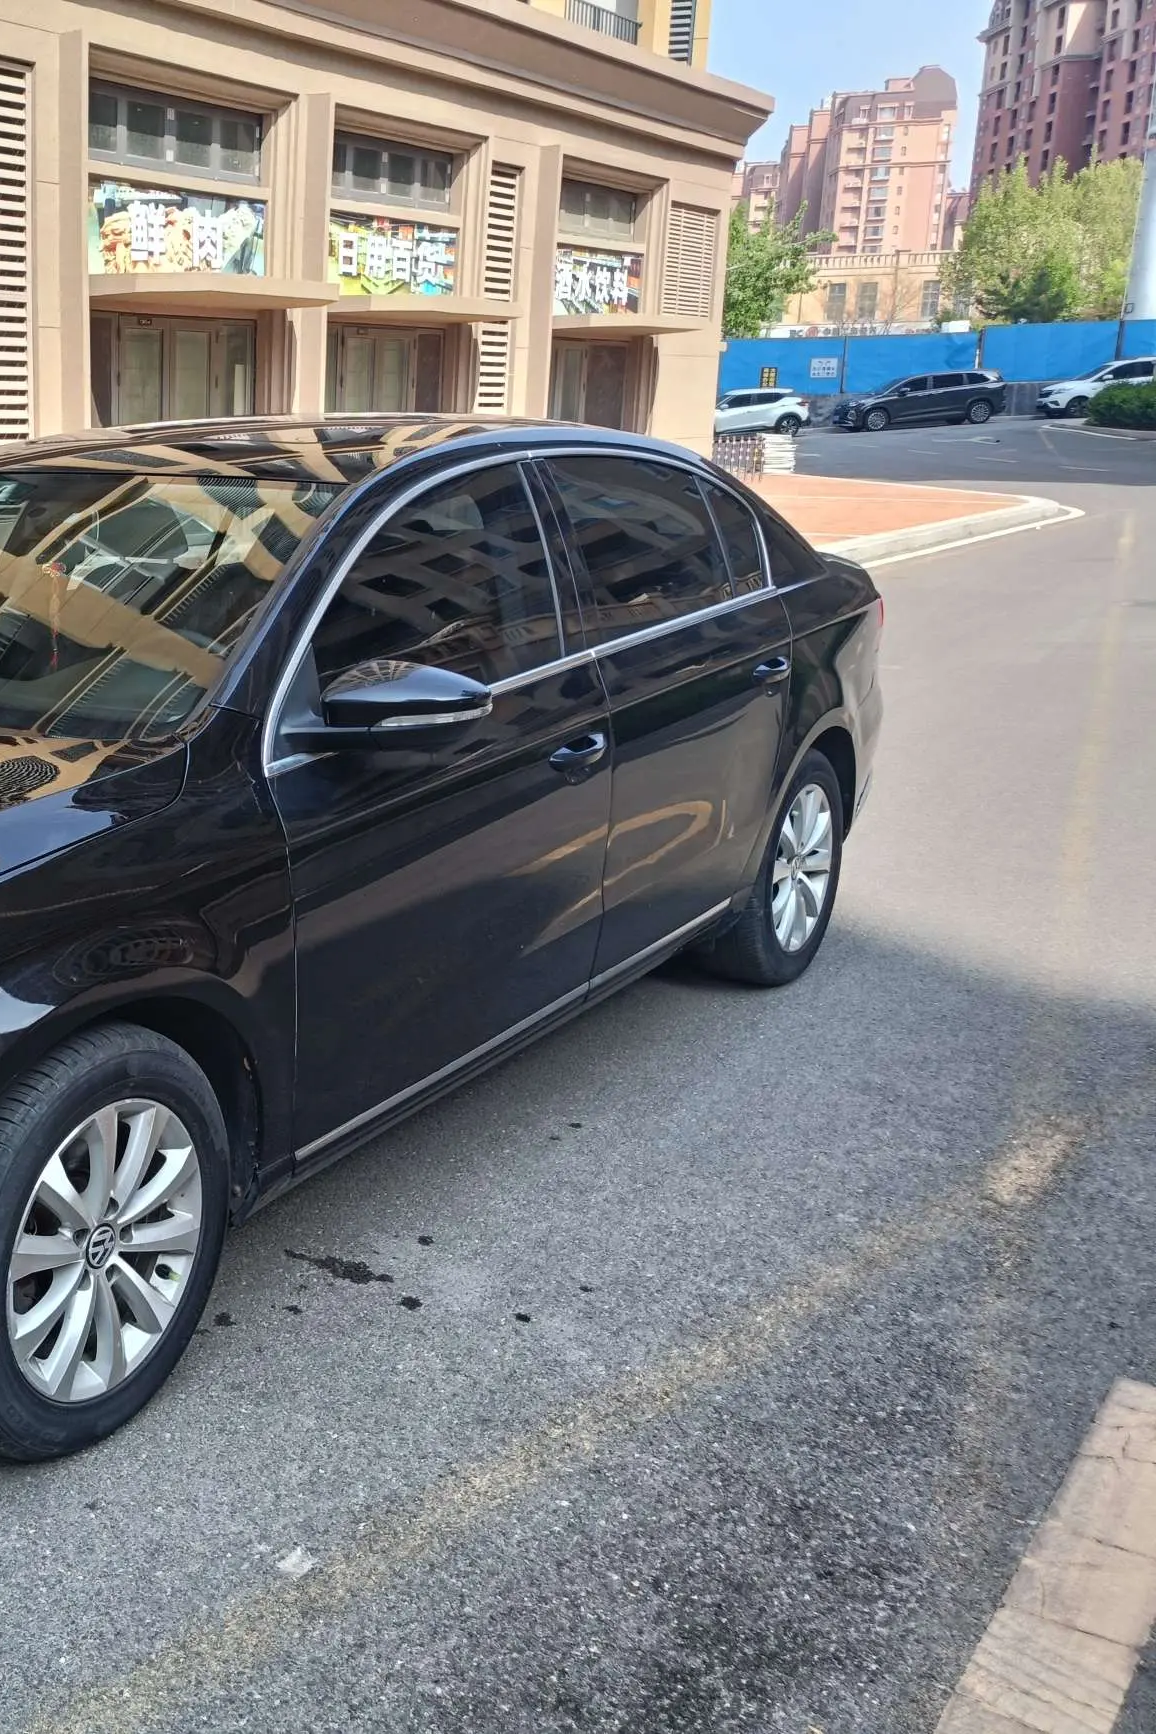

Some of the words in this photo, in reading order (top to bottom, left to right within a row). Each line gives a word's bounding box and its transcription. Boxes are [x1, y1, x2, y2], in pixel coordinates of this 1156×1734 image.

[126, 200, 224, 270] 鲜肉
[338, 232, 454, 286] 日用百货
[555, 263, 629, 306] 酒水饮料
